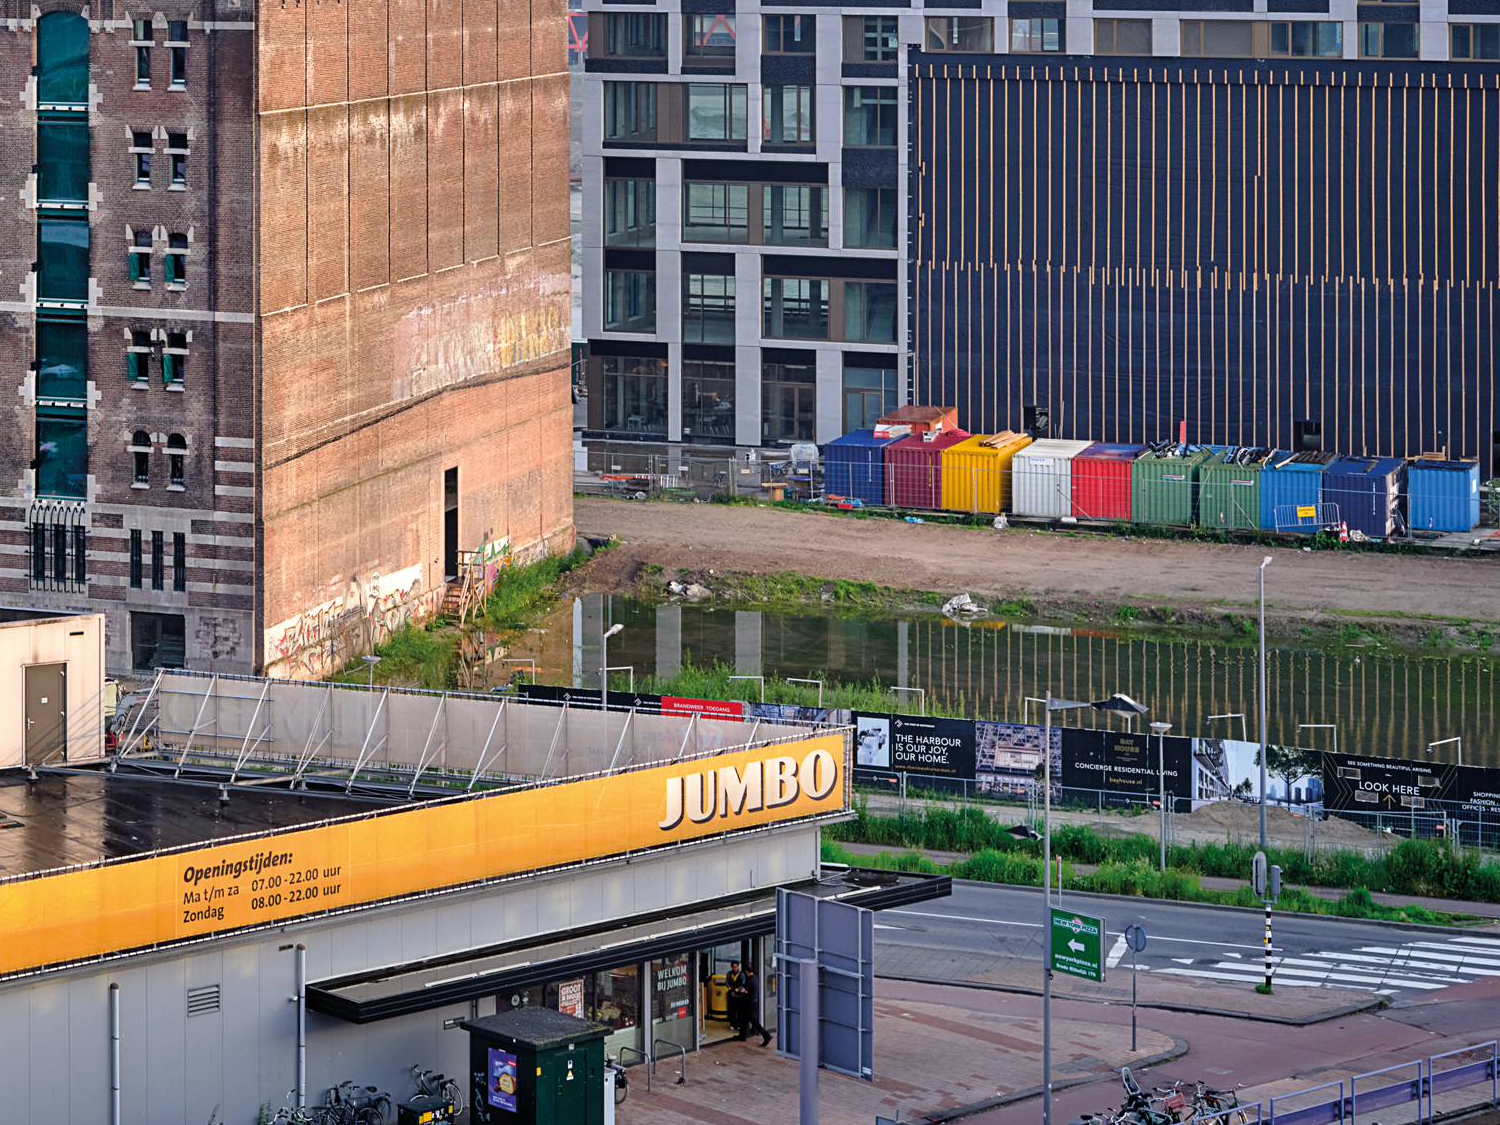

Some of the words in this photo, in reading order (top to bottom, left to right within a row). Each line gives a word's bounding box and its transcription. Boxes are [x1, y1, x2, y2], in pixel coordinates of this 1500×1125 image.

[895, 734, 913, 743] THE
[916, 735, 961, 747] HARBOUR
[895, 743, 904, 751] IS
[906, 744, 926, 753] OUR
[928, 746, 948, 756] JOY,
[895, 752, 916, 761] OUR
[918, 754, 950, 764] HOME.
[1075, 762, 1112, 771] CONCIERGE
[1114, 766, 1154, 775] RESIDENTIAL
[1357, 761, 1385, 769] SOMETHING
[1109, 777, 1143, 785] bayhouse.nl
[658, 749, 838, 831] JUMBO
[1359, 781, 1389, 793] LOOK
[1392, 785, 1420, 795] HERE
[184, 851, 293, 886] Openingstijden:
[184, 893, 200, 904] Ma
[204, 887, 224, 902] t/m
[228, 885, 239, 896] za
[323, 866, 341, 878] uur
[184, 906, 224, 923] Zondag
[323, 884, 341, 896] uur
[1055, 918, 1067, 926] NEW
[658, 965, 687, 980] WELKOM
[561, 984, 581, 995] GROOT
[667, 977, 687, 990] JUMBO
[670, 999, 689, 1008] JUMBO
